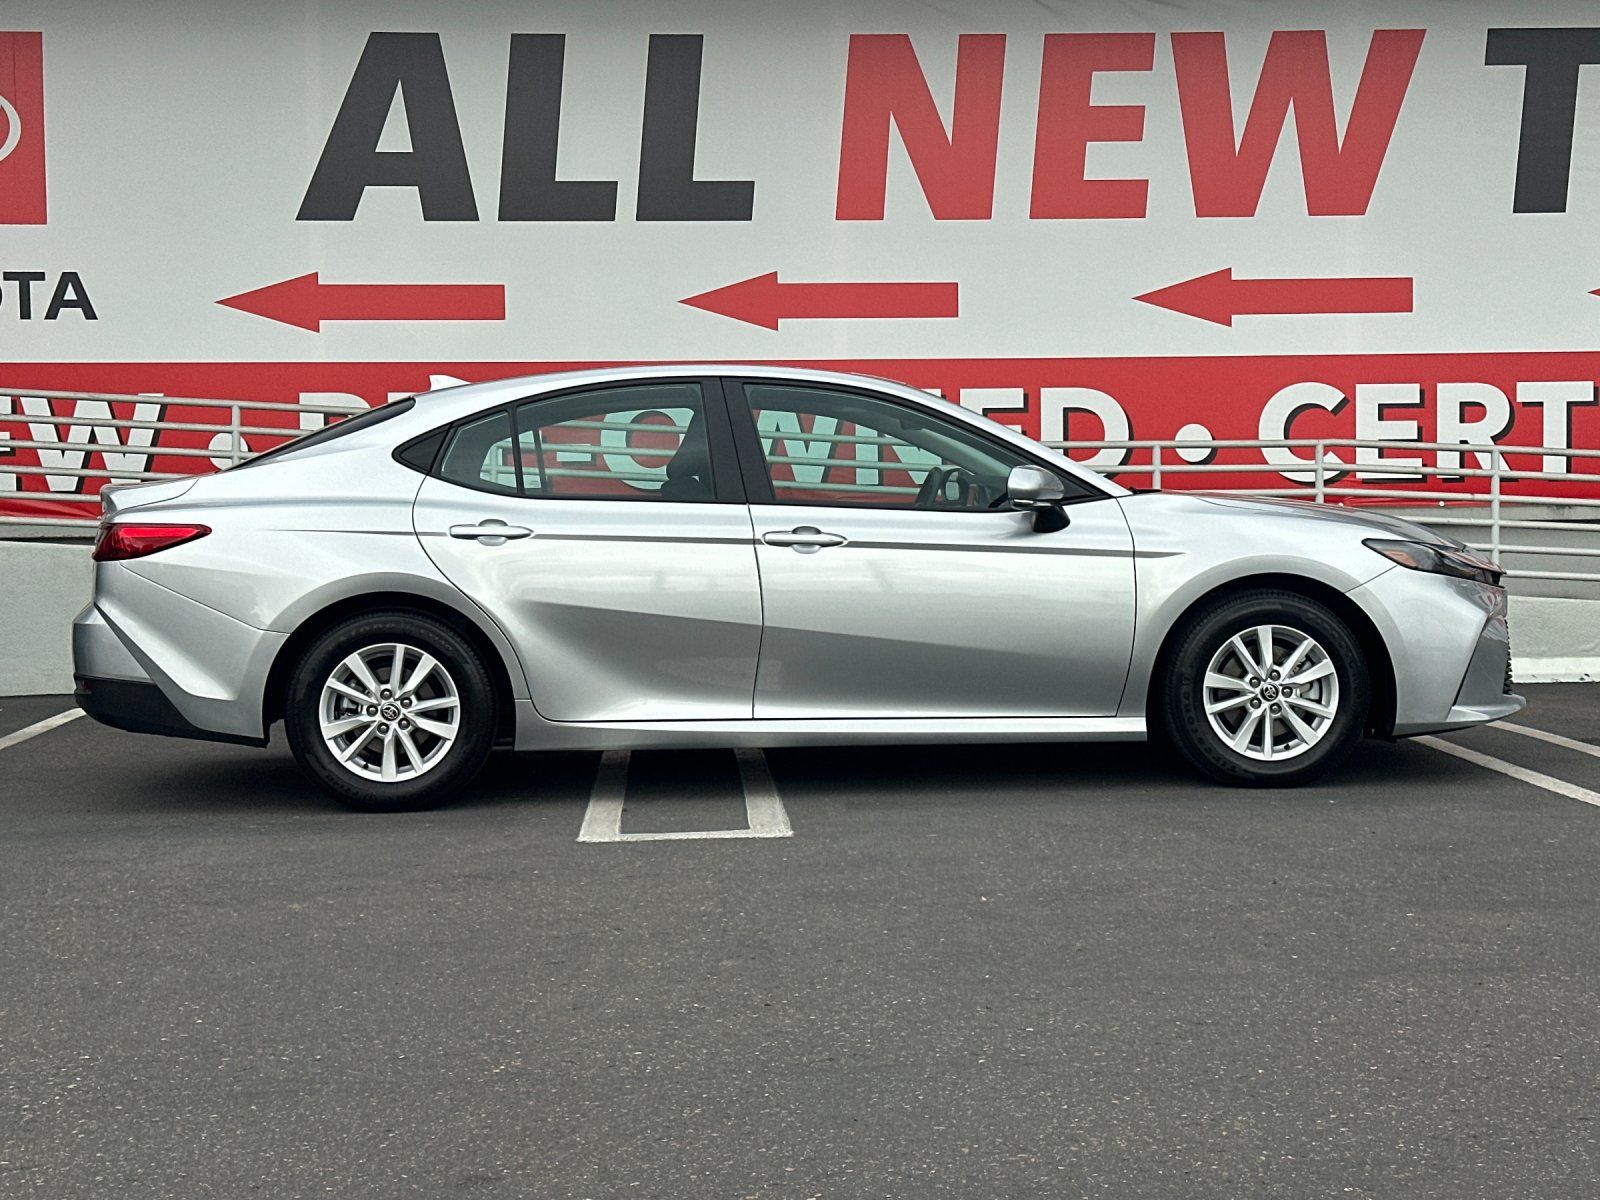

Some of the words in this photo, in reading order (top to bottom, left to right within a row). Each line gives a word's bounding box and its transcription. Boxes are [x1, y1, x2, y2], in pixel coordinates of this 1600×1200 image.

[295, 32, 755, 221] ALL
[835, 29, 1427, 221] NEW
[1485, 27, 1600, 214] T
[0, 271, 98, 320] TA
[0, 392, 166, 494] W
[1258, 381, 1596, 484] CERT
